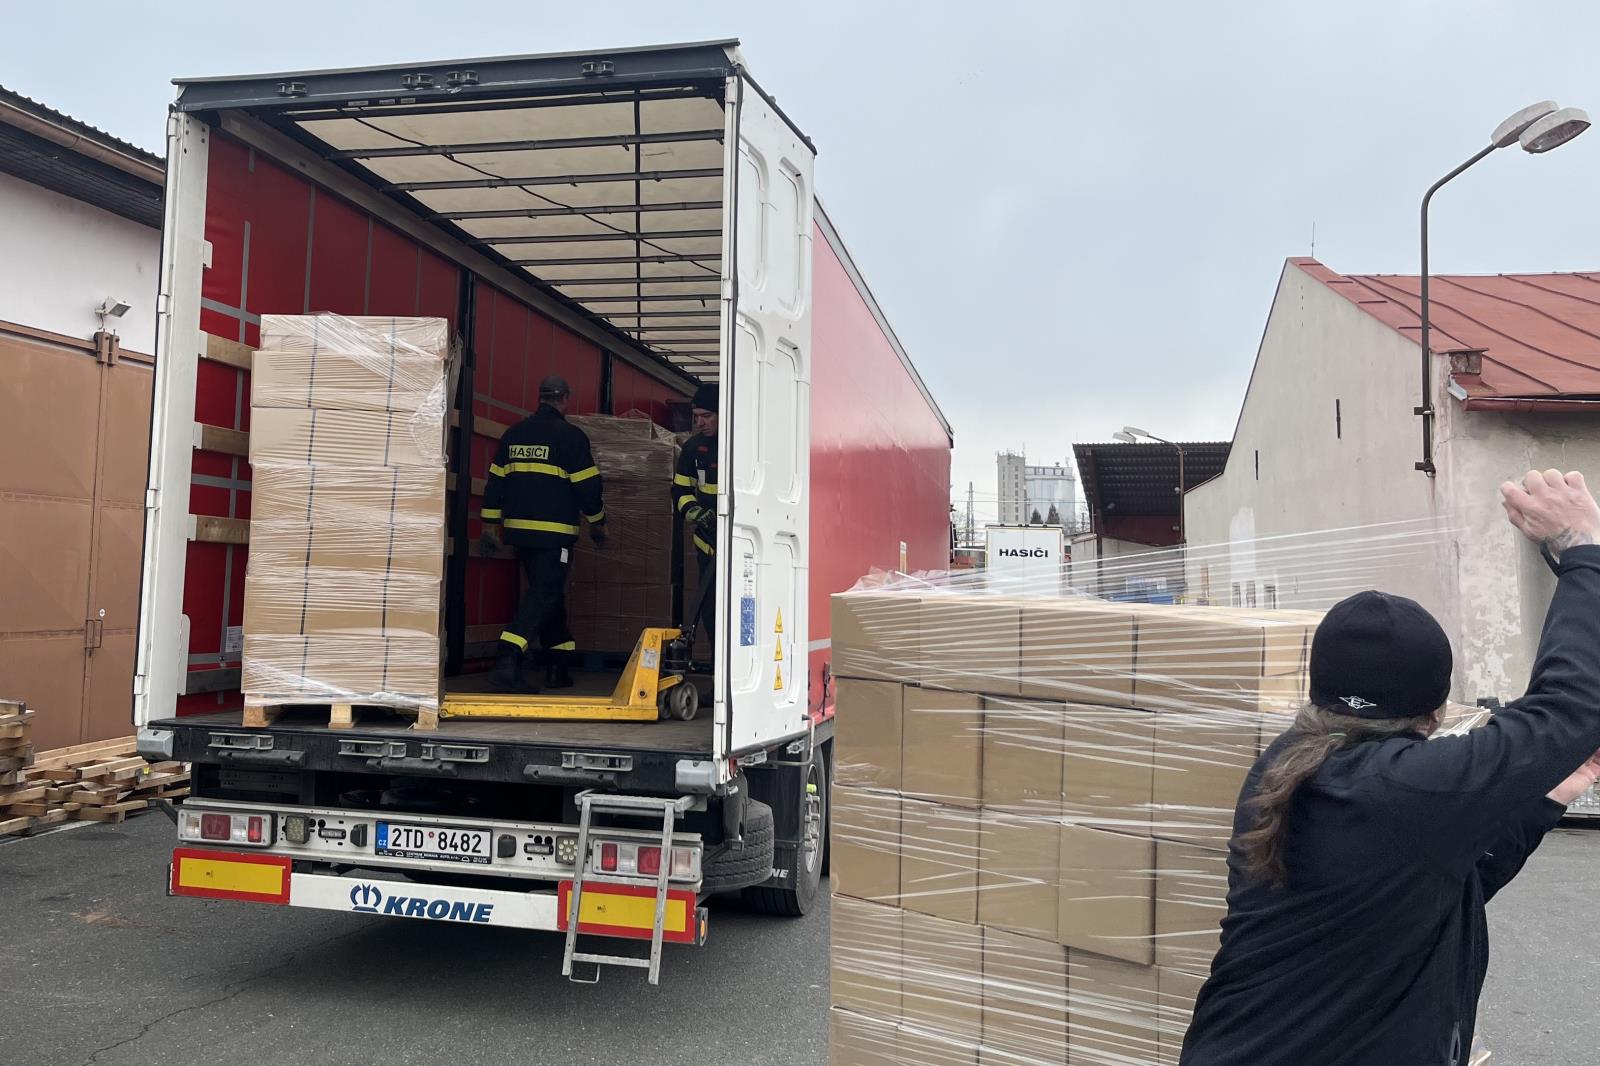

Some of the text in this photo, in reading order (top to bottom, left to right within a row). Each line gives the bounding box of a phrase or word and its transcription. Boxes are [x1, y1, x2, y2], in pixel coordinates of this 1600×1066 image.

[999, 547, 1049, 558] HASIČI
[391, 828, 482, 854] 2TD 8482
[383, 895, 494, 922] KRONE
